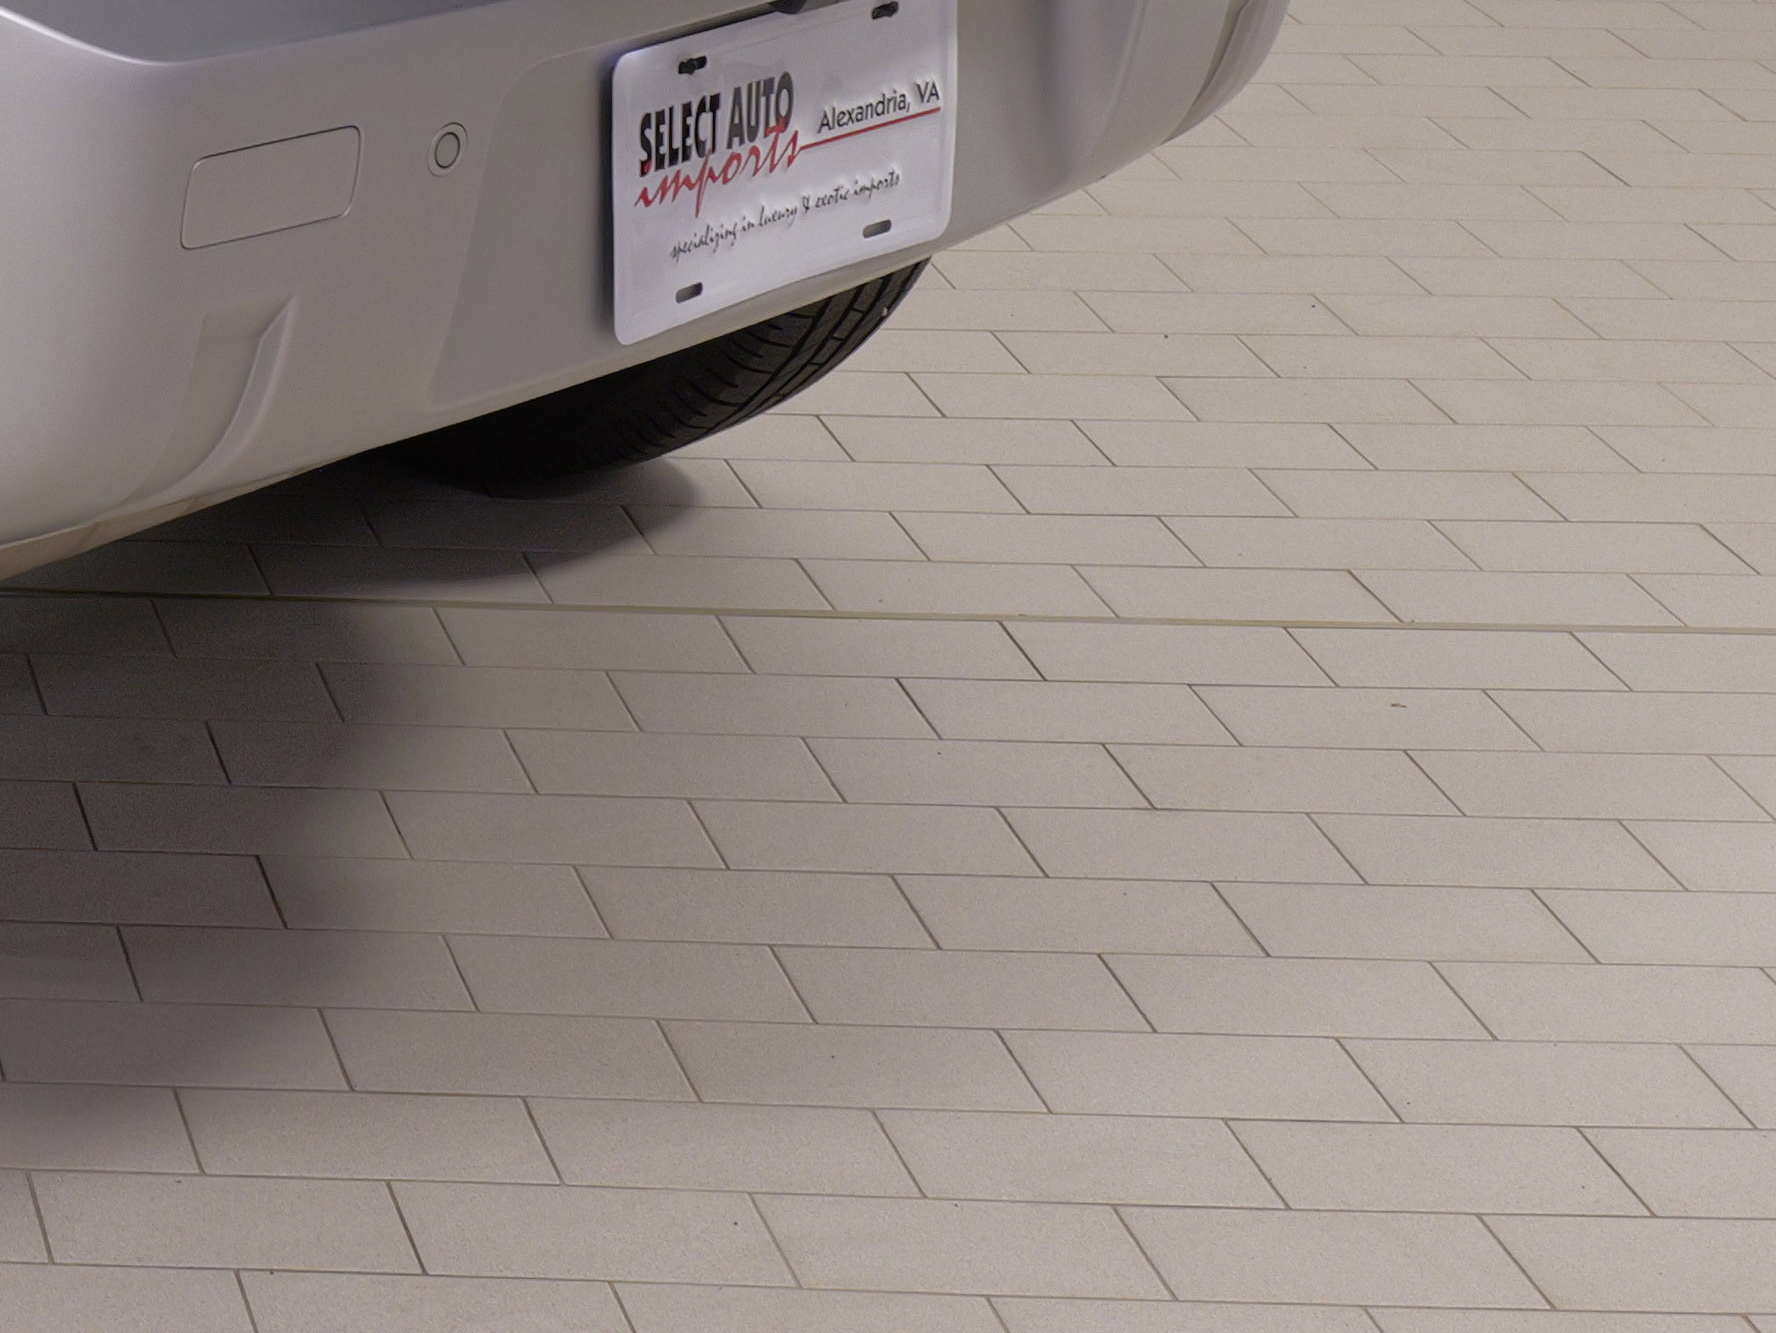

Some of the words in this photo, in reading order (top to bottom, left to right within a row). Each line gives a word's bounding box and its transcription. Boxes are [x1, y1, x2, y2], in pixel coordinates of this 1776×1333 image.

[639, 93, 721, 178] SELECT
[726, 71, 794, 151] AUTO
[817, 88, 911, 134] Alexandria,
[913, 79, 940, 104] VA
[633, 117, 800, 218] imports
[740, 216, 755, 233] in
[758, 203, 799, 233] luxury
[814, 183, 850, 209] exotic
[852, 167, 901, 203] imports
